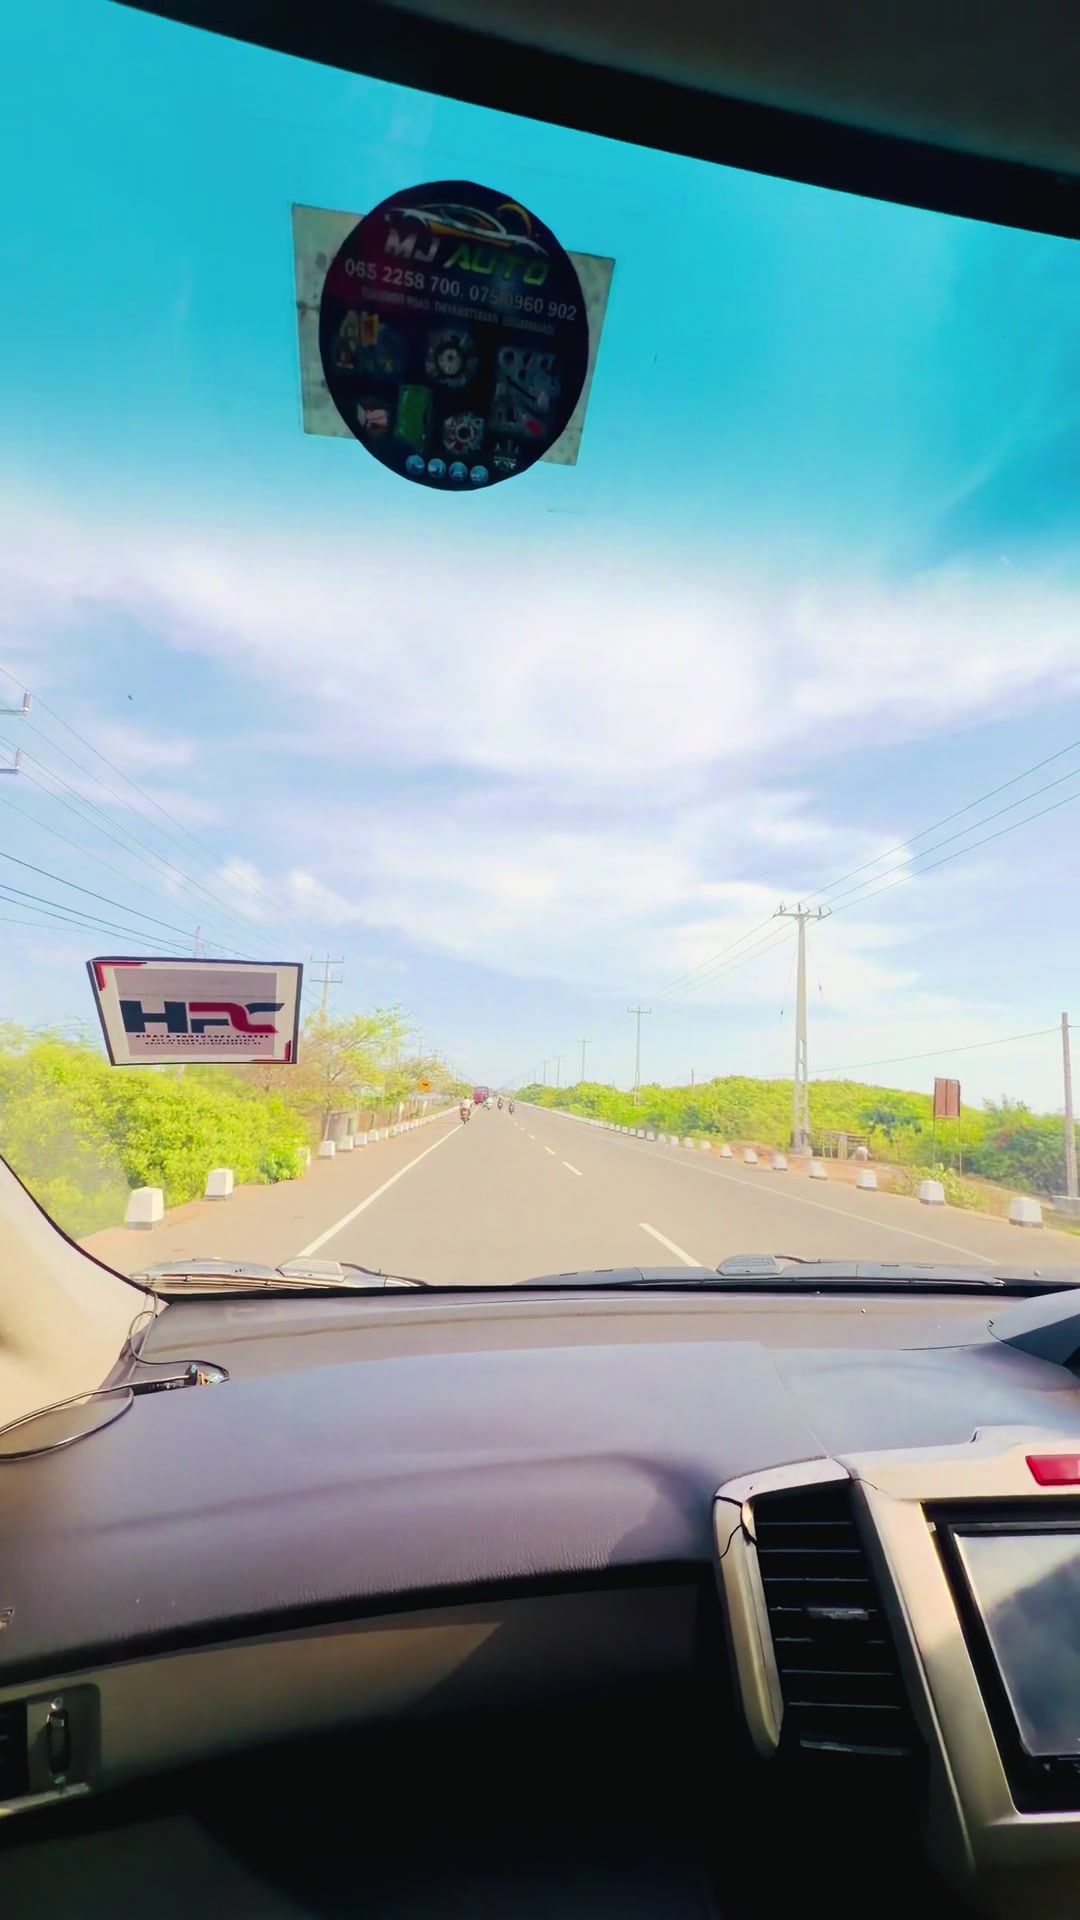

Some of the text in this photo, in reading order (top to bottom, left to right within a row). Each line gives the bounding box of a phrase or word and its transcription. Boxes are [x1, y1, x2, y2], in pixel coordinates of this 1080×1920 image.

[384, 228, 550, 287] MJ AUTO
[345, 258, 377, 280] 065
[381, 266, 424, 289] 2258
[548, 301, 577, 321] 902
[119, 999, 286, 1034] HPC
